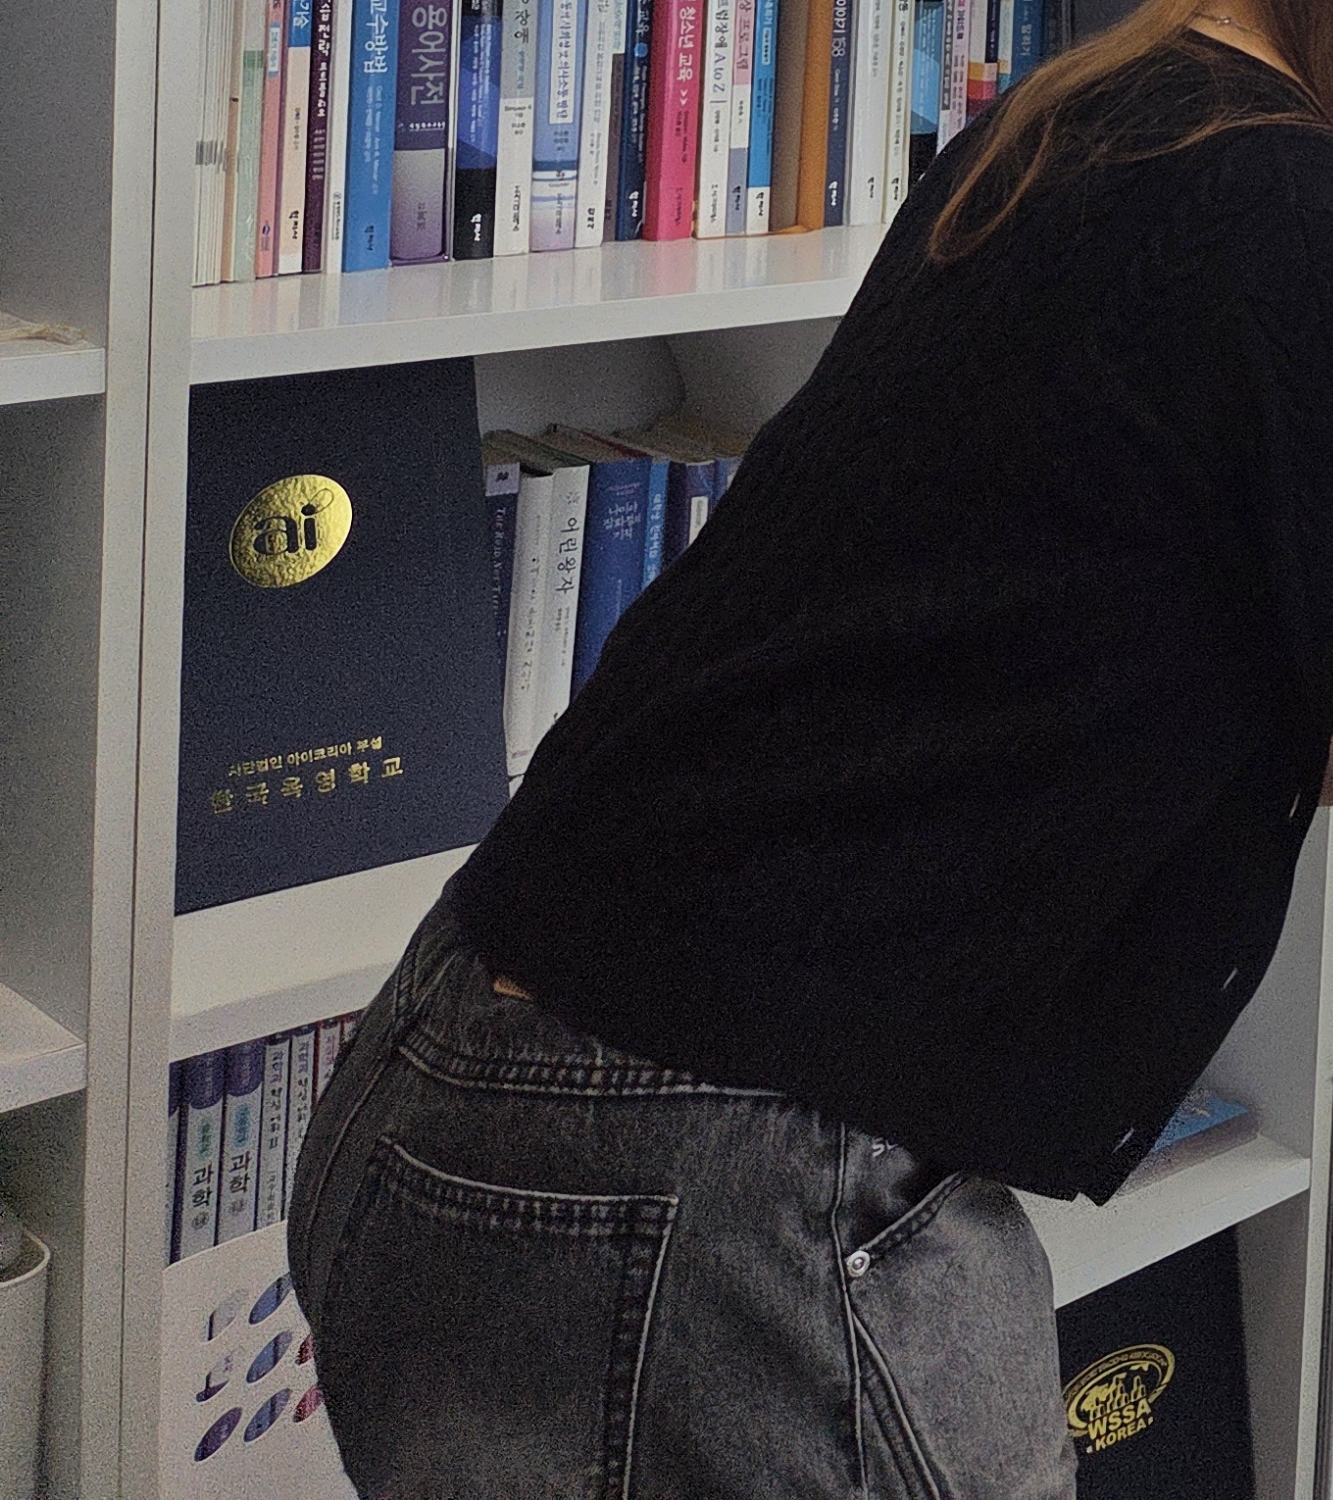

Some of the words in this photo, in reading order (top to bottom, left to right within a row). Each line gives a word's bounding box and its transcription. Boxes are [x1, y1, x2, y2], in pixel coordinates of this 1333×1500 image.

[677, 6, 697, 49] 청소년
[408, 2, 449, 108] 용어사전
[676, 52, 694, 82] 교육
[555, 517, 580, 594] 어린왕자
[1088, 1398, 1152, 1440] WSSA
[1095, 1418, 1147, 1451] KOREA
